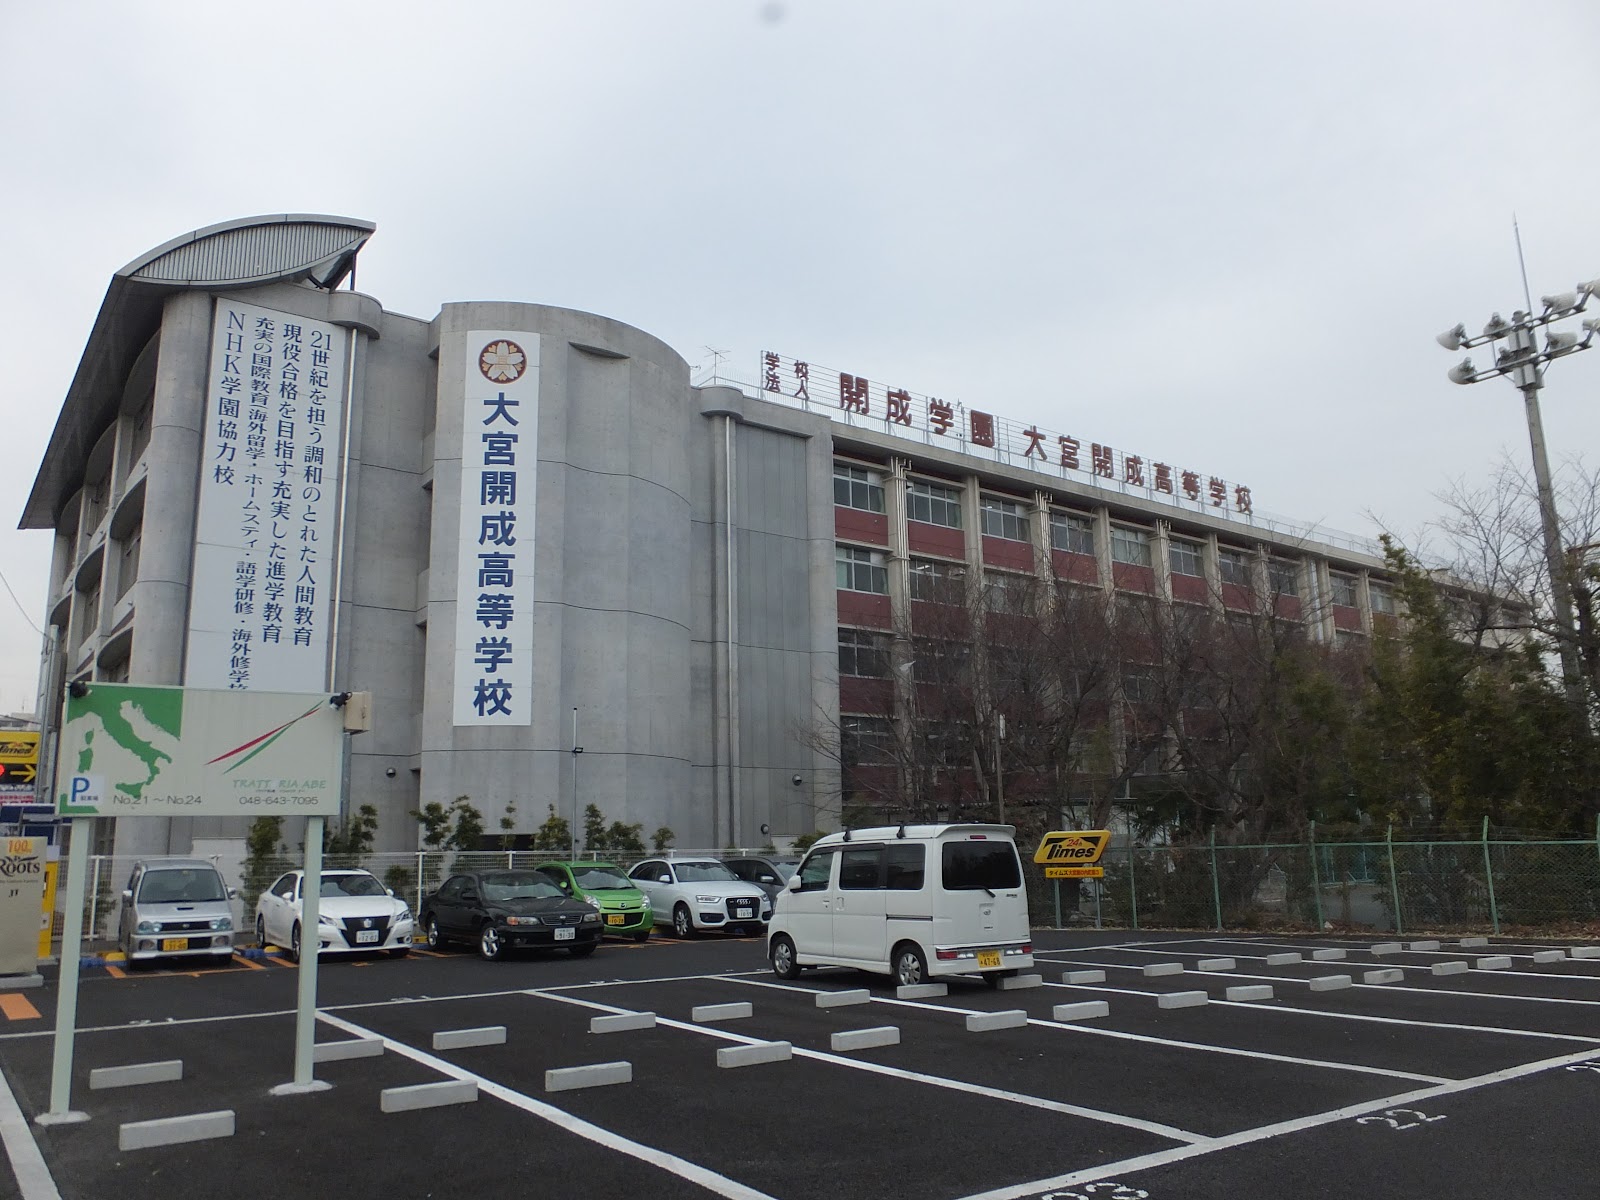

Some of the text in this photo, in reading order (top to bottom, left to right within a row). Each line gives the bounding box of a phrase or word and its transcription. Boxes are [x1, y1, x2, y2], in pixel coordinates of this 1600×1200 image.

[213, 310, 247, 487] NHK学園協力校
[838, 371, 995, 448] 開成学園
[261, 322, 303, 645] 現役合格を目指す充実した進学教育
[292, 329, 334, 648] 21世紀を担う調和のとれた人間教育
[1022, 424, 1254, 515] 大宮開成高等学校
[472, 391, 521, 717] 大宮開成高等学校
[71, 777, 90, 802] P
[238, 796, 320, 805] 048-643-7095
[302, 779, 328, 789] ABE
[1046, 843, 1096, 860] Times
[984, 957, 1001, 966] 47-68
[1355, 1108, 1448, 1131] 22
